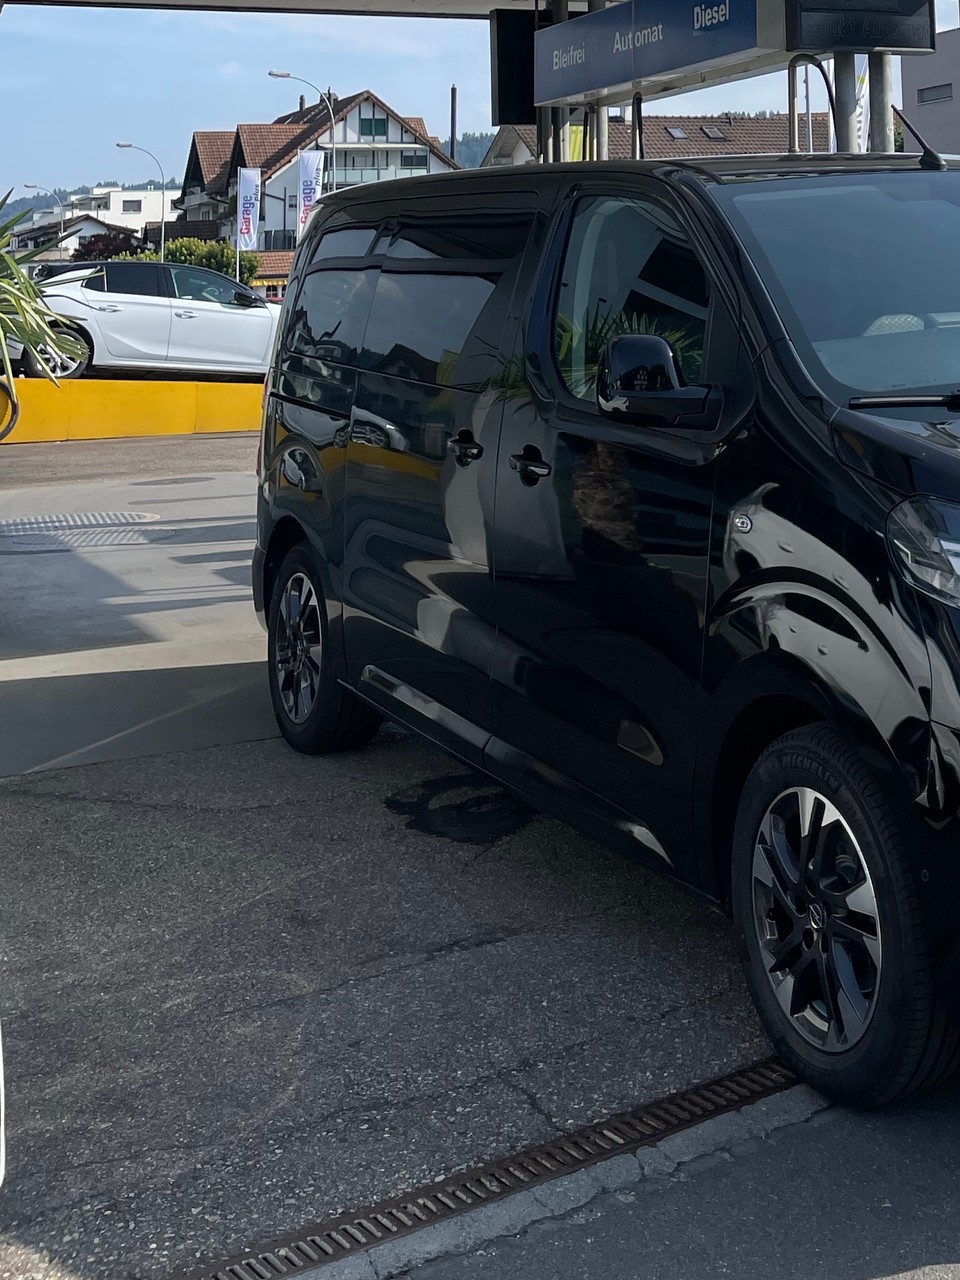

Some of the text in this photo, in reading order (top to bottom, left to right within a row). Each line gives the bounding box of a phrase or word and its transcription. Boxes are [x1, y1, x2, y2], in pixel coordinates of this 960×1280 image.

[553, 42, 585, 70] Bleifrei
[613, 22, 663, 53] Automat
[313, 167, 321, 187] plus
[240, 195, 255, 235] Garage
[300, 180, 316, 224] Garage
[782, 753, 842, 793] MICHELIN
